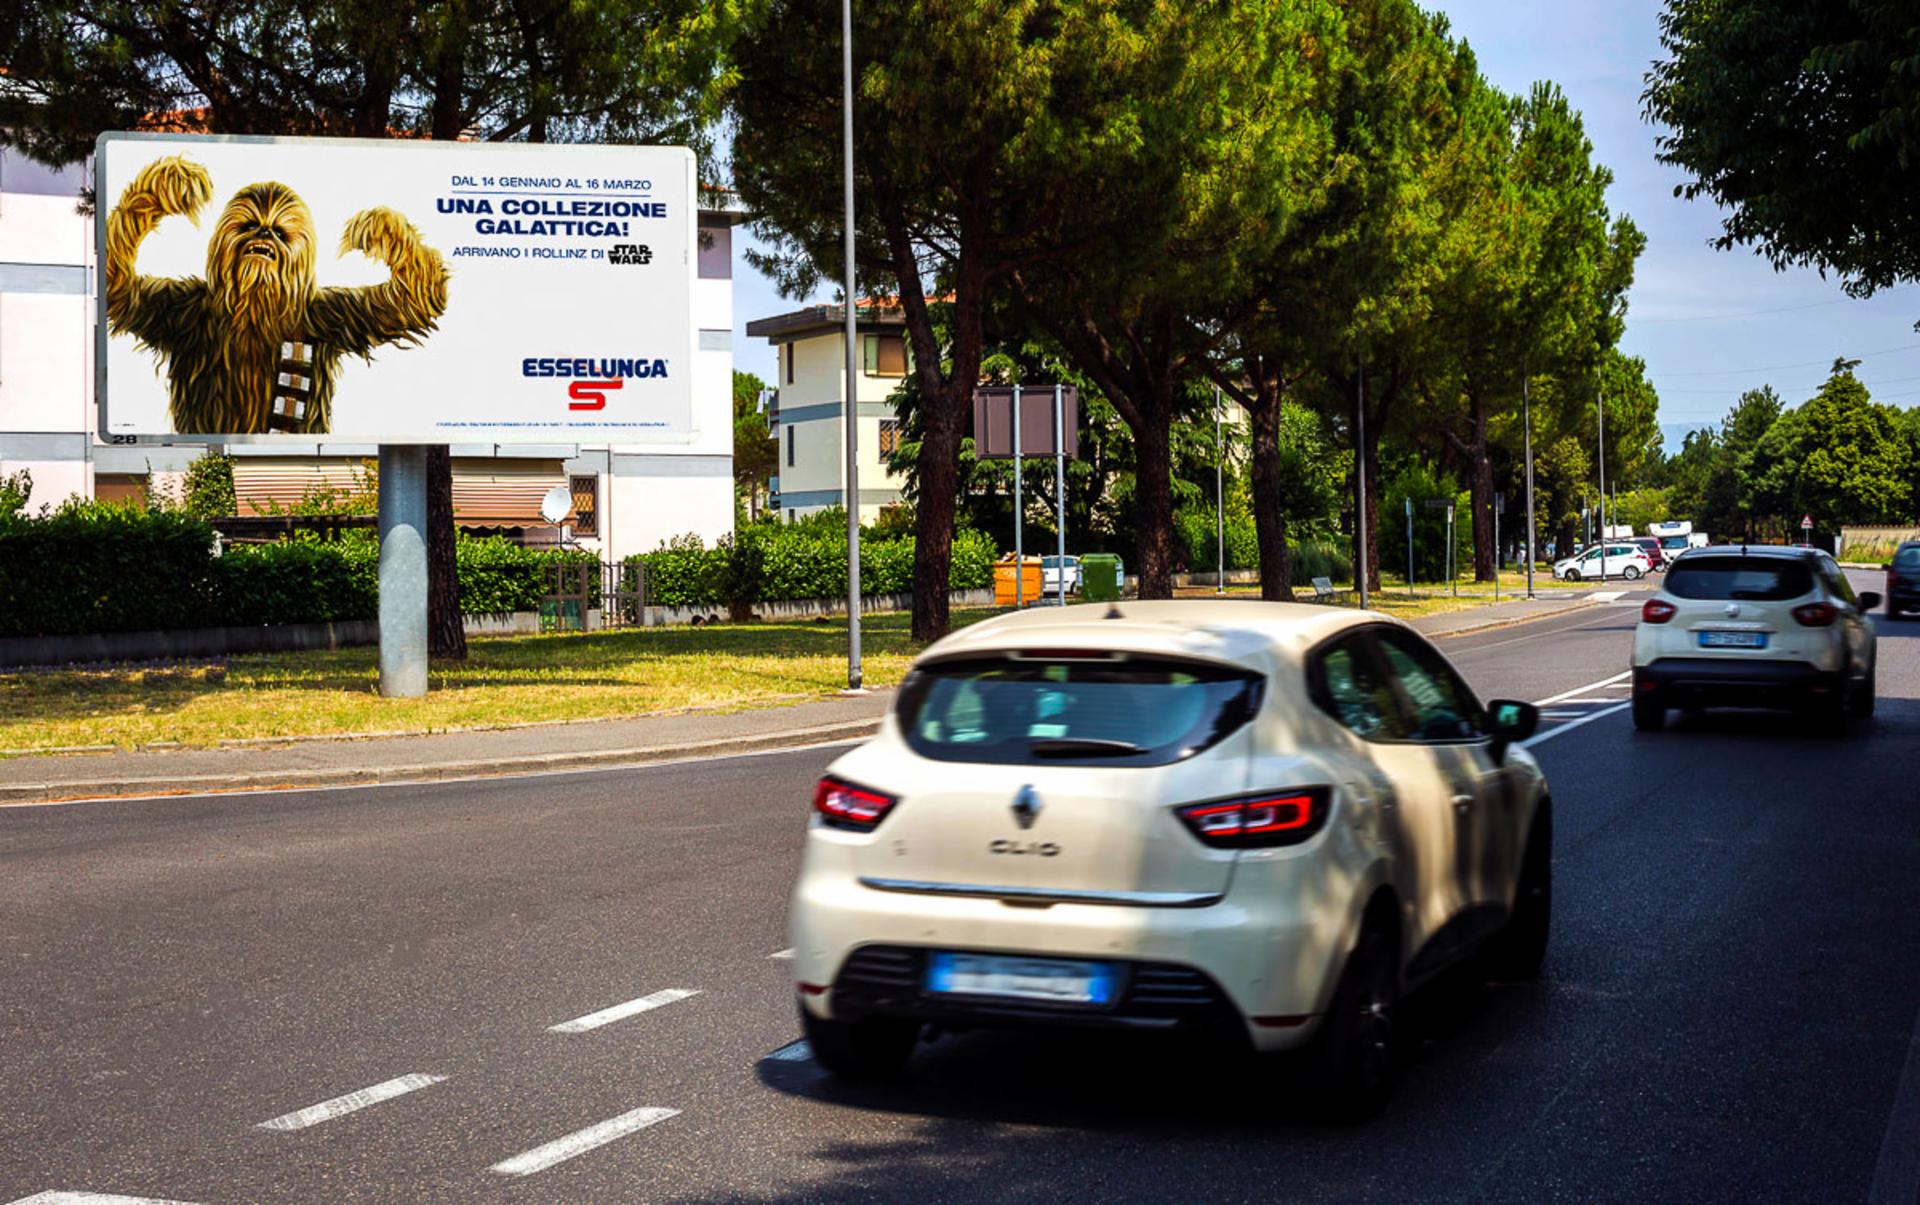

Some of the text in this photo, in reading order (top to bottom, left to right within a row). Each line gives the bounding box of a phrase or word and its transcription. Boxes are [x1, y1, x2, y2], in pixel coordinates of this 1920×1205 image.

[452, 176, 652, 190] DAL 14 GENNAIO AL 16 MARZO
[437, 198, 667, 218] UNA COLLEZIONE
[475, 219, 629, 237] GALATTICA!
[453, 244, 652, 259] ARRIVANO I ROLLINZ DI STAR
[608, 254, 652, 265] WARS
[522, 358, 668, 378] ESSELUNGA
[113, 434, 137, 445] 28
